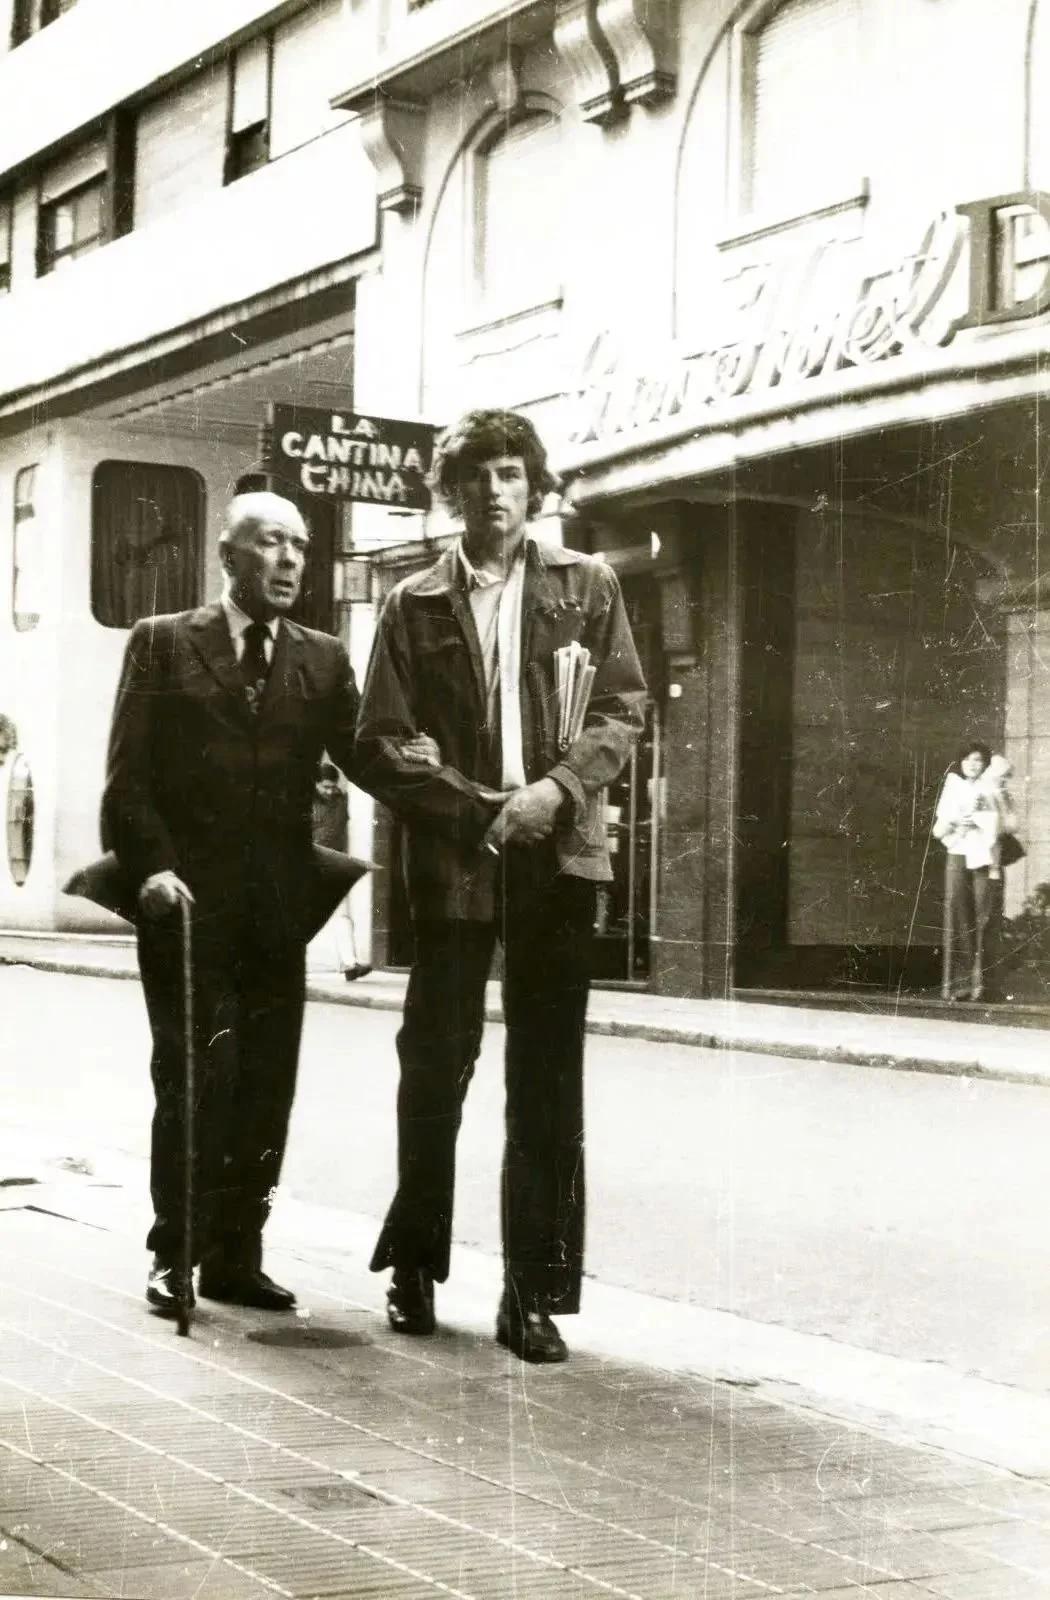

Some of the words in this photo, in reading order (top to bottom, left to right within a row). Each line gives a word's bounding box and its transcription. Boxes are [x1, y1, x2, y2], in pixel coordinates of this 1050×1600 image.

[331, 415, 377, 438] LA
[281, 431, 423, 474] CANTINA
[301, 463, 405, 501] CHINA
